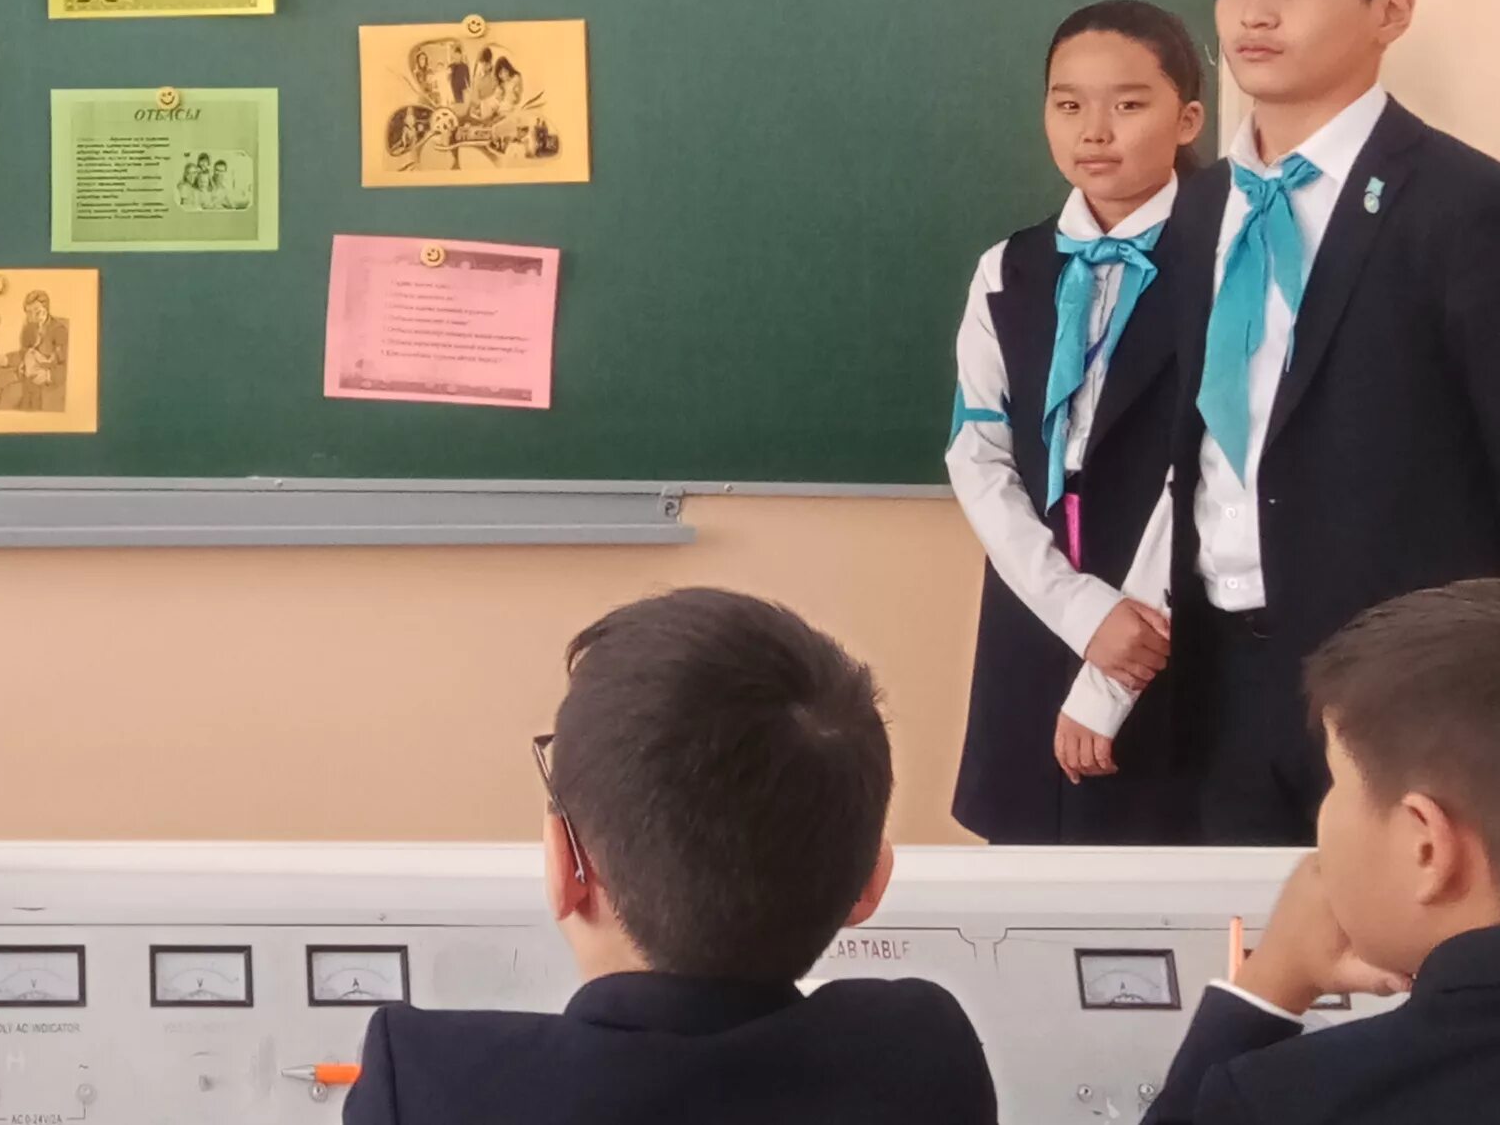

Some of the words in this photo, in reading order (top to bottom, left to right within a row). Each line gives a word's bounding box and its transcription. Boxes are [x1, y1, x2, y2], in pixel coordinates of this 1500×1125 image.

[827, 939, 857, 959] AB
[16, 1022, 29, 1034] AC
[32, 1022, 81, 1034] INDICATOR
